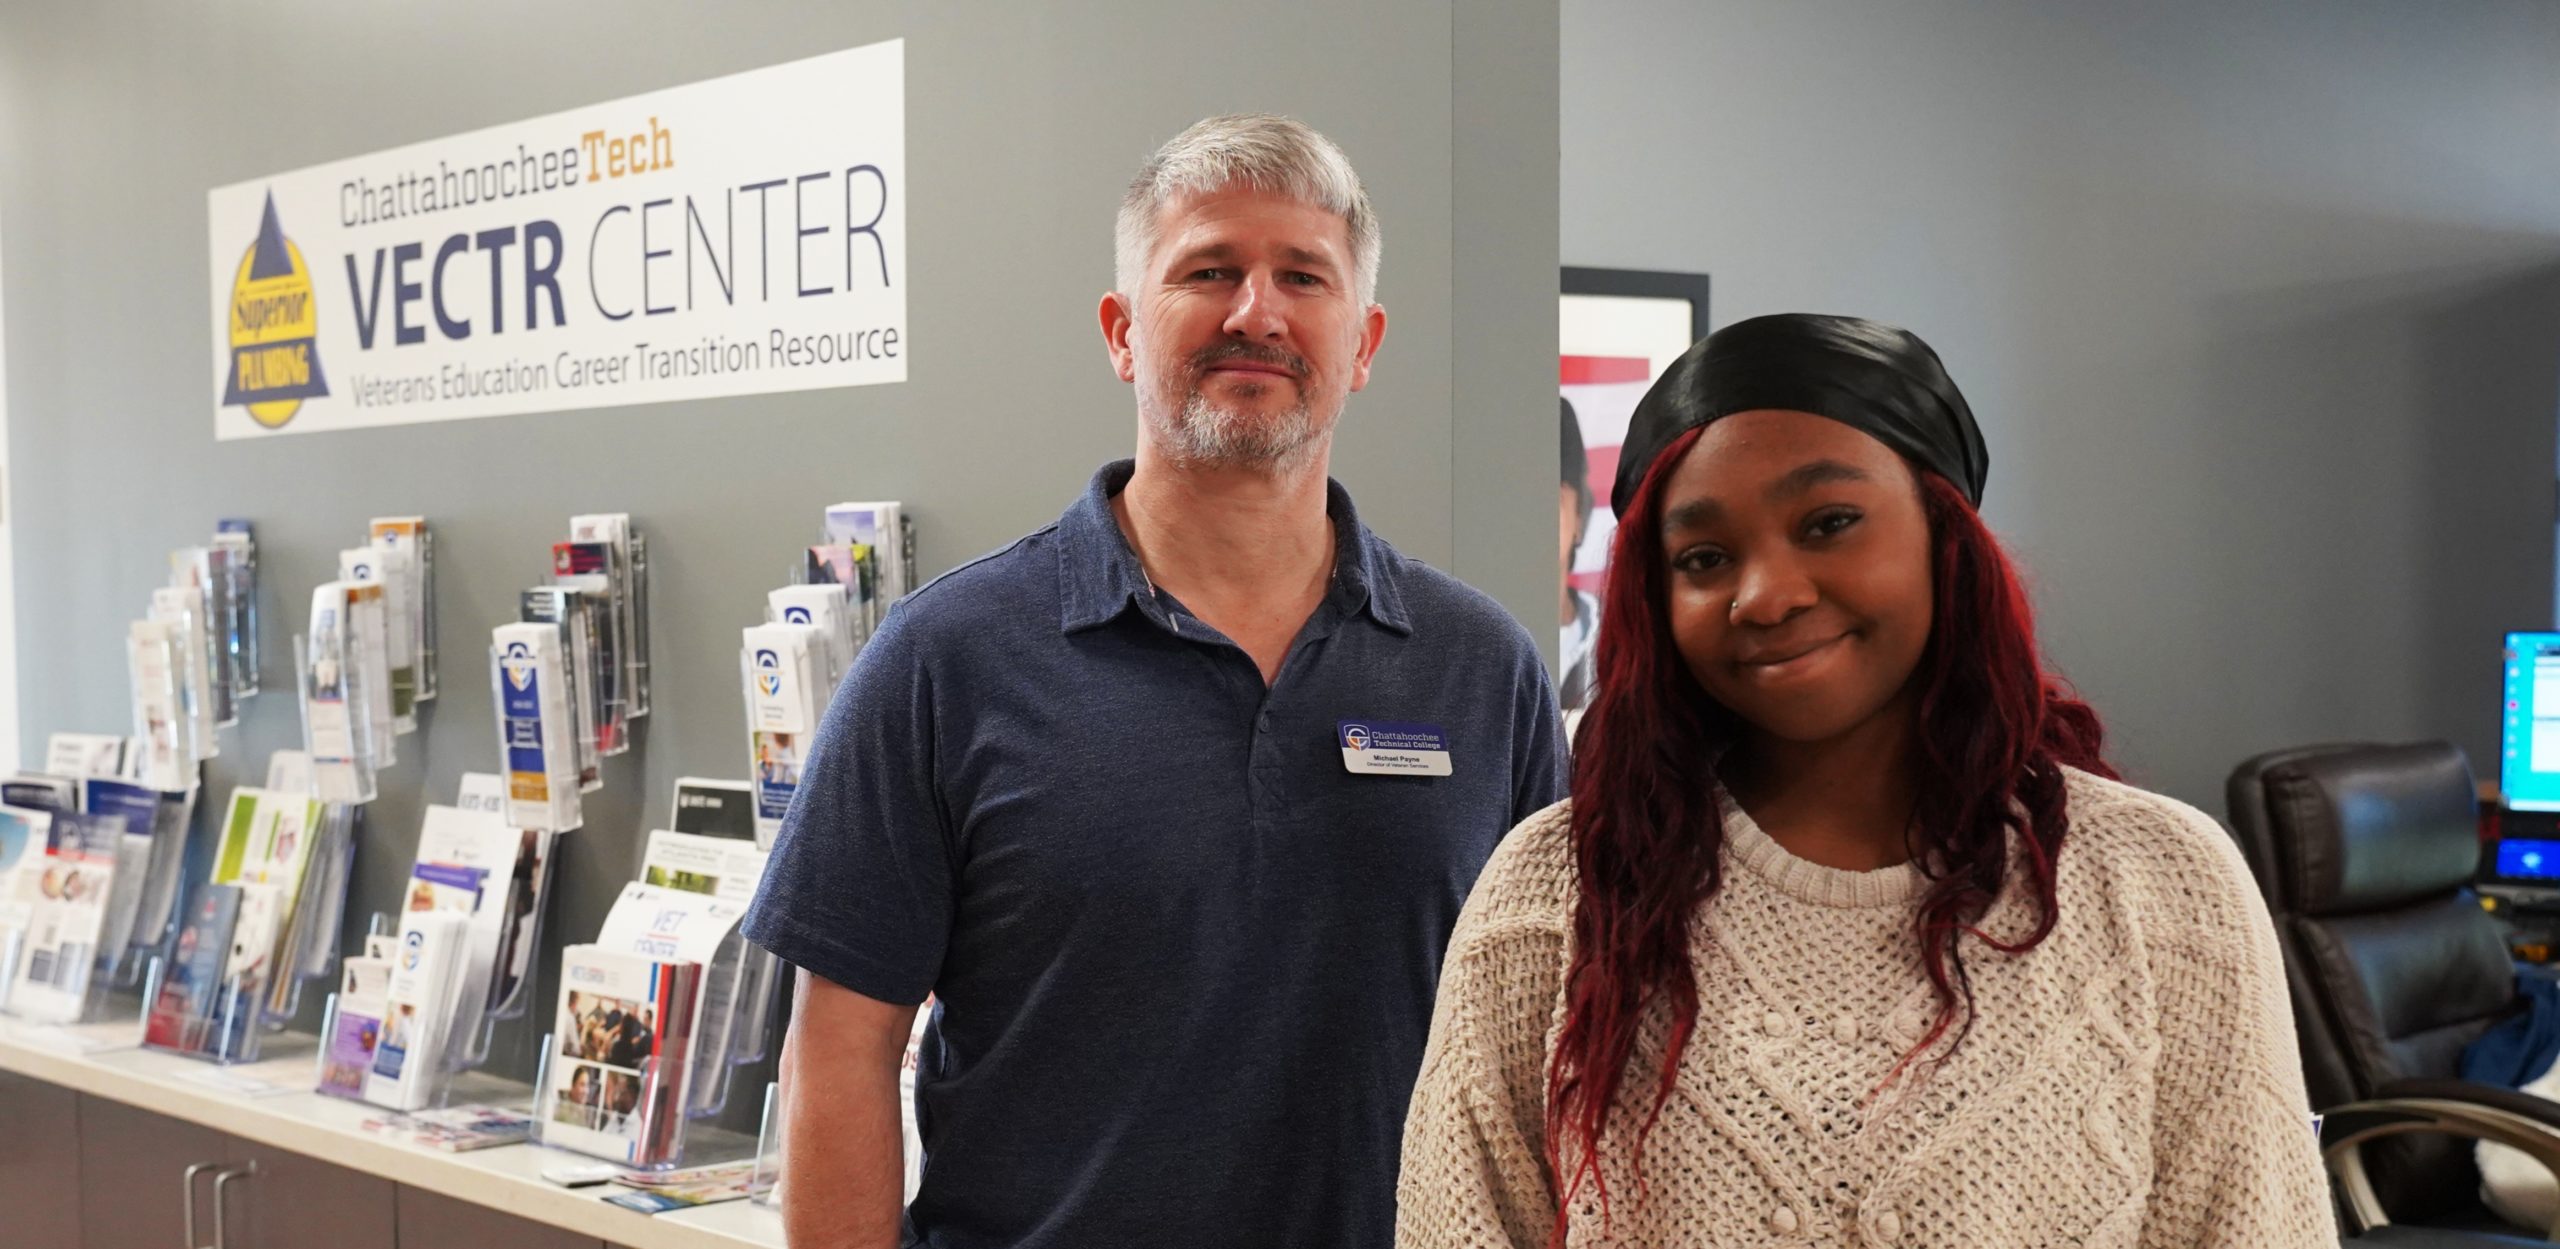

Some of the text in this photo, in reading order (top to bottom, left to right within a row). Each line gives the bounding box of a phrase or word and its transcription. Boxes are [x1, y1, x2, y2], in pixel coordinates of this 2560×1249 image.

[345, 164, 891, 350] VECTR CENTER
[236, 290, 309, 340] Superior
[351, 326, 899, 408] Veterans Education Career Transition Resource
[1371, 731, 1440, 742] Chattahoochee
[1373, 740, 1441, 750] Technical College
[1373, 754, 1420, 763] Michael Payne
